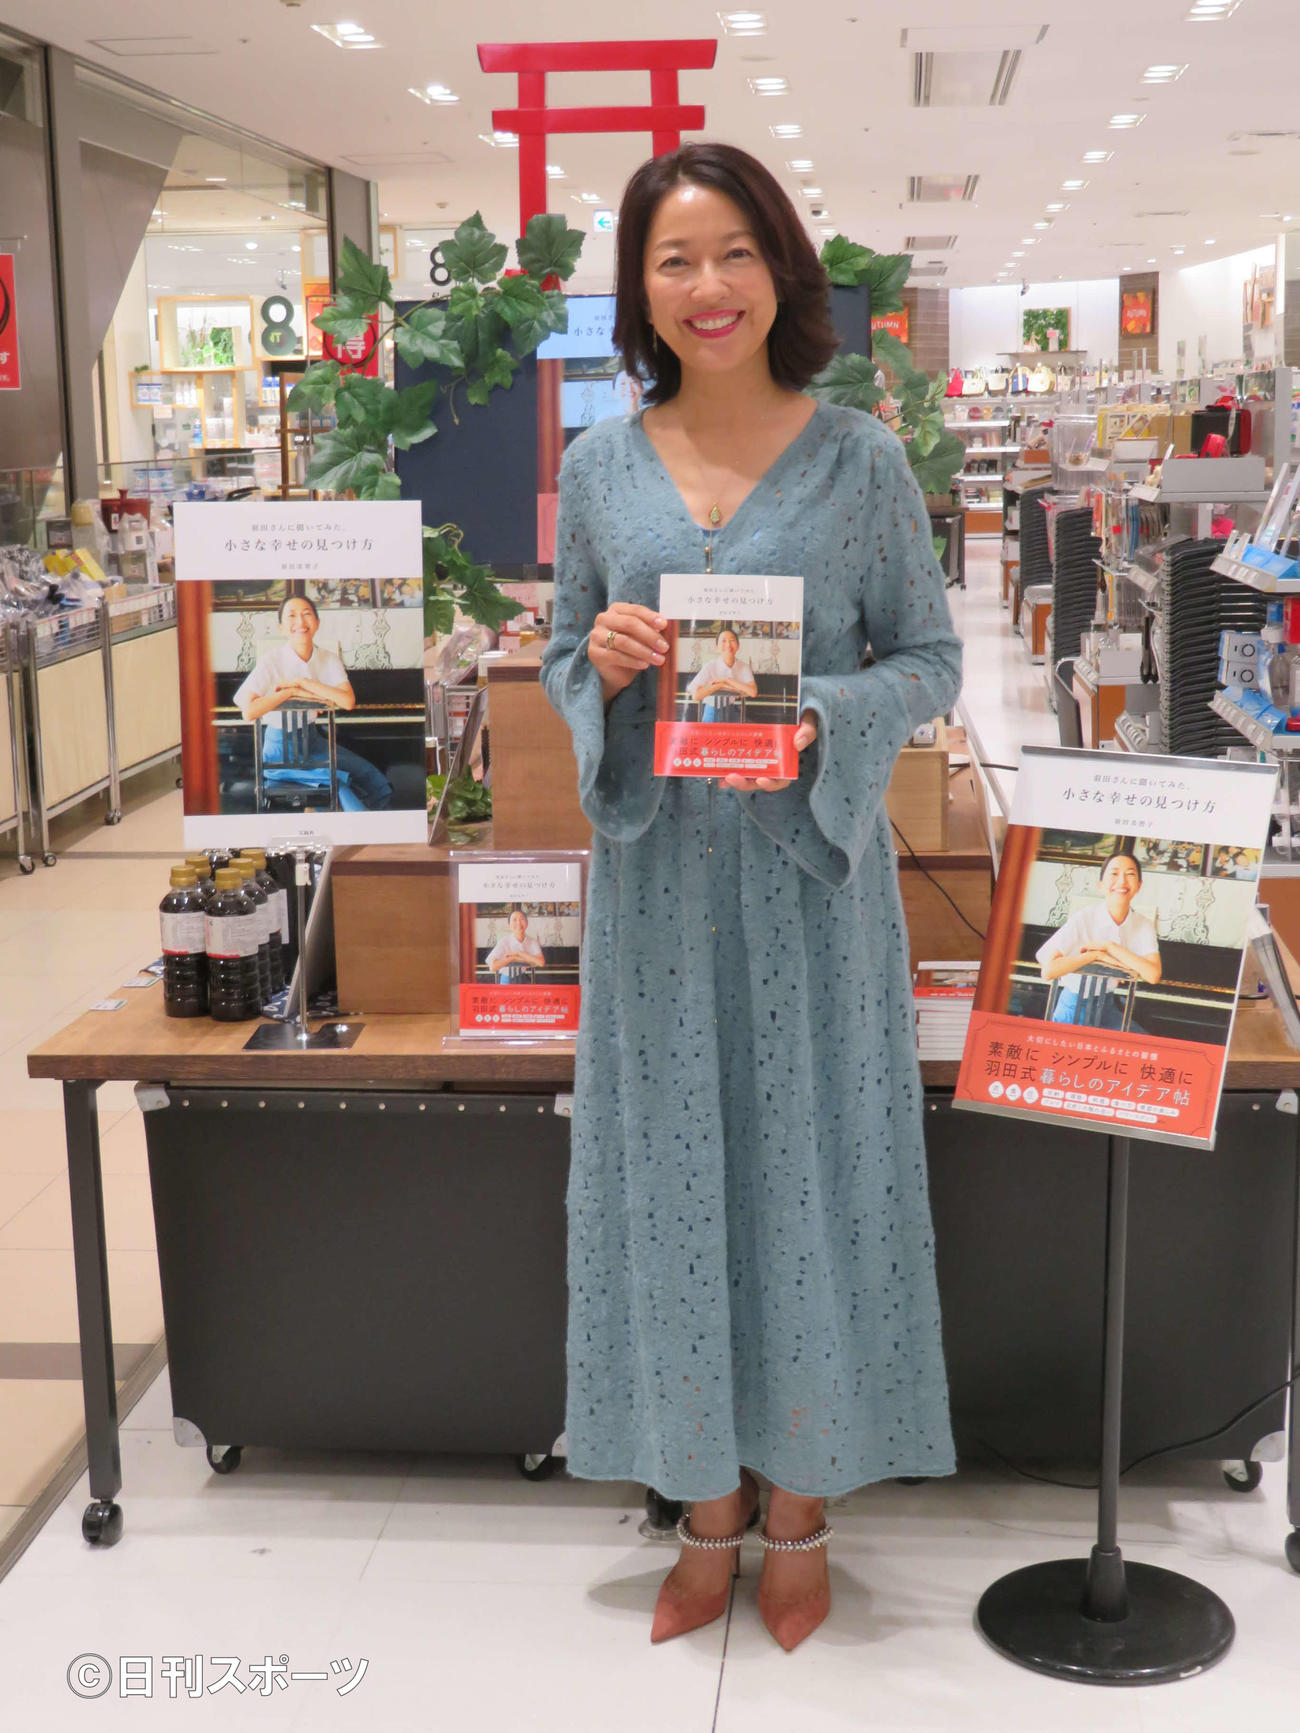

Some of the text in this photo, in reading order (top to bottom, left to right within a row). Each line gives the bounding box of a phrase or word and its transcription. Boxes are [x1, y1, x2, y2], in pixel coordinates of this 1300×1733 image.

[574, 326, 614, 337] 小さな
[871, 319, 900, 330] UTUMN
[224, 537, 375, 552] 小さな幸せの見つけ方
[1062, 787, 1217, 815] 小さな幸せの見つけ方
[987, 1041, 1194, 1085] 素敵に シンプルに 快適に
[984, 1059, 1192, 1107] 羽田式暮らしのアイデア帖
